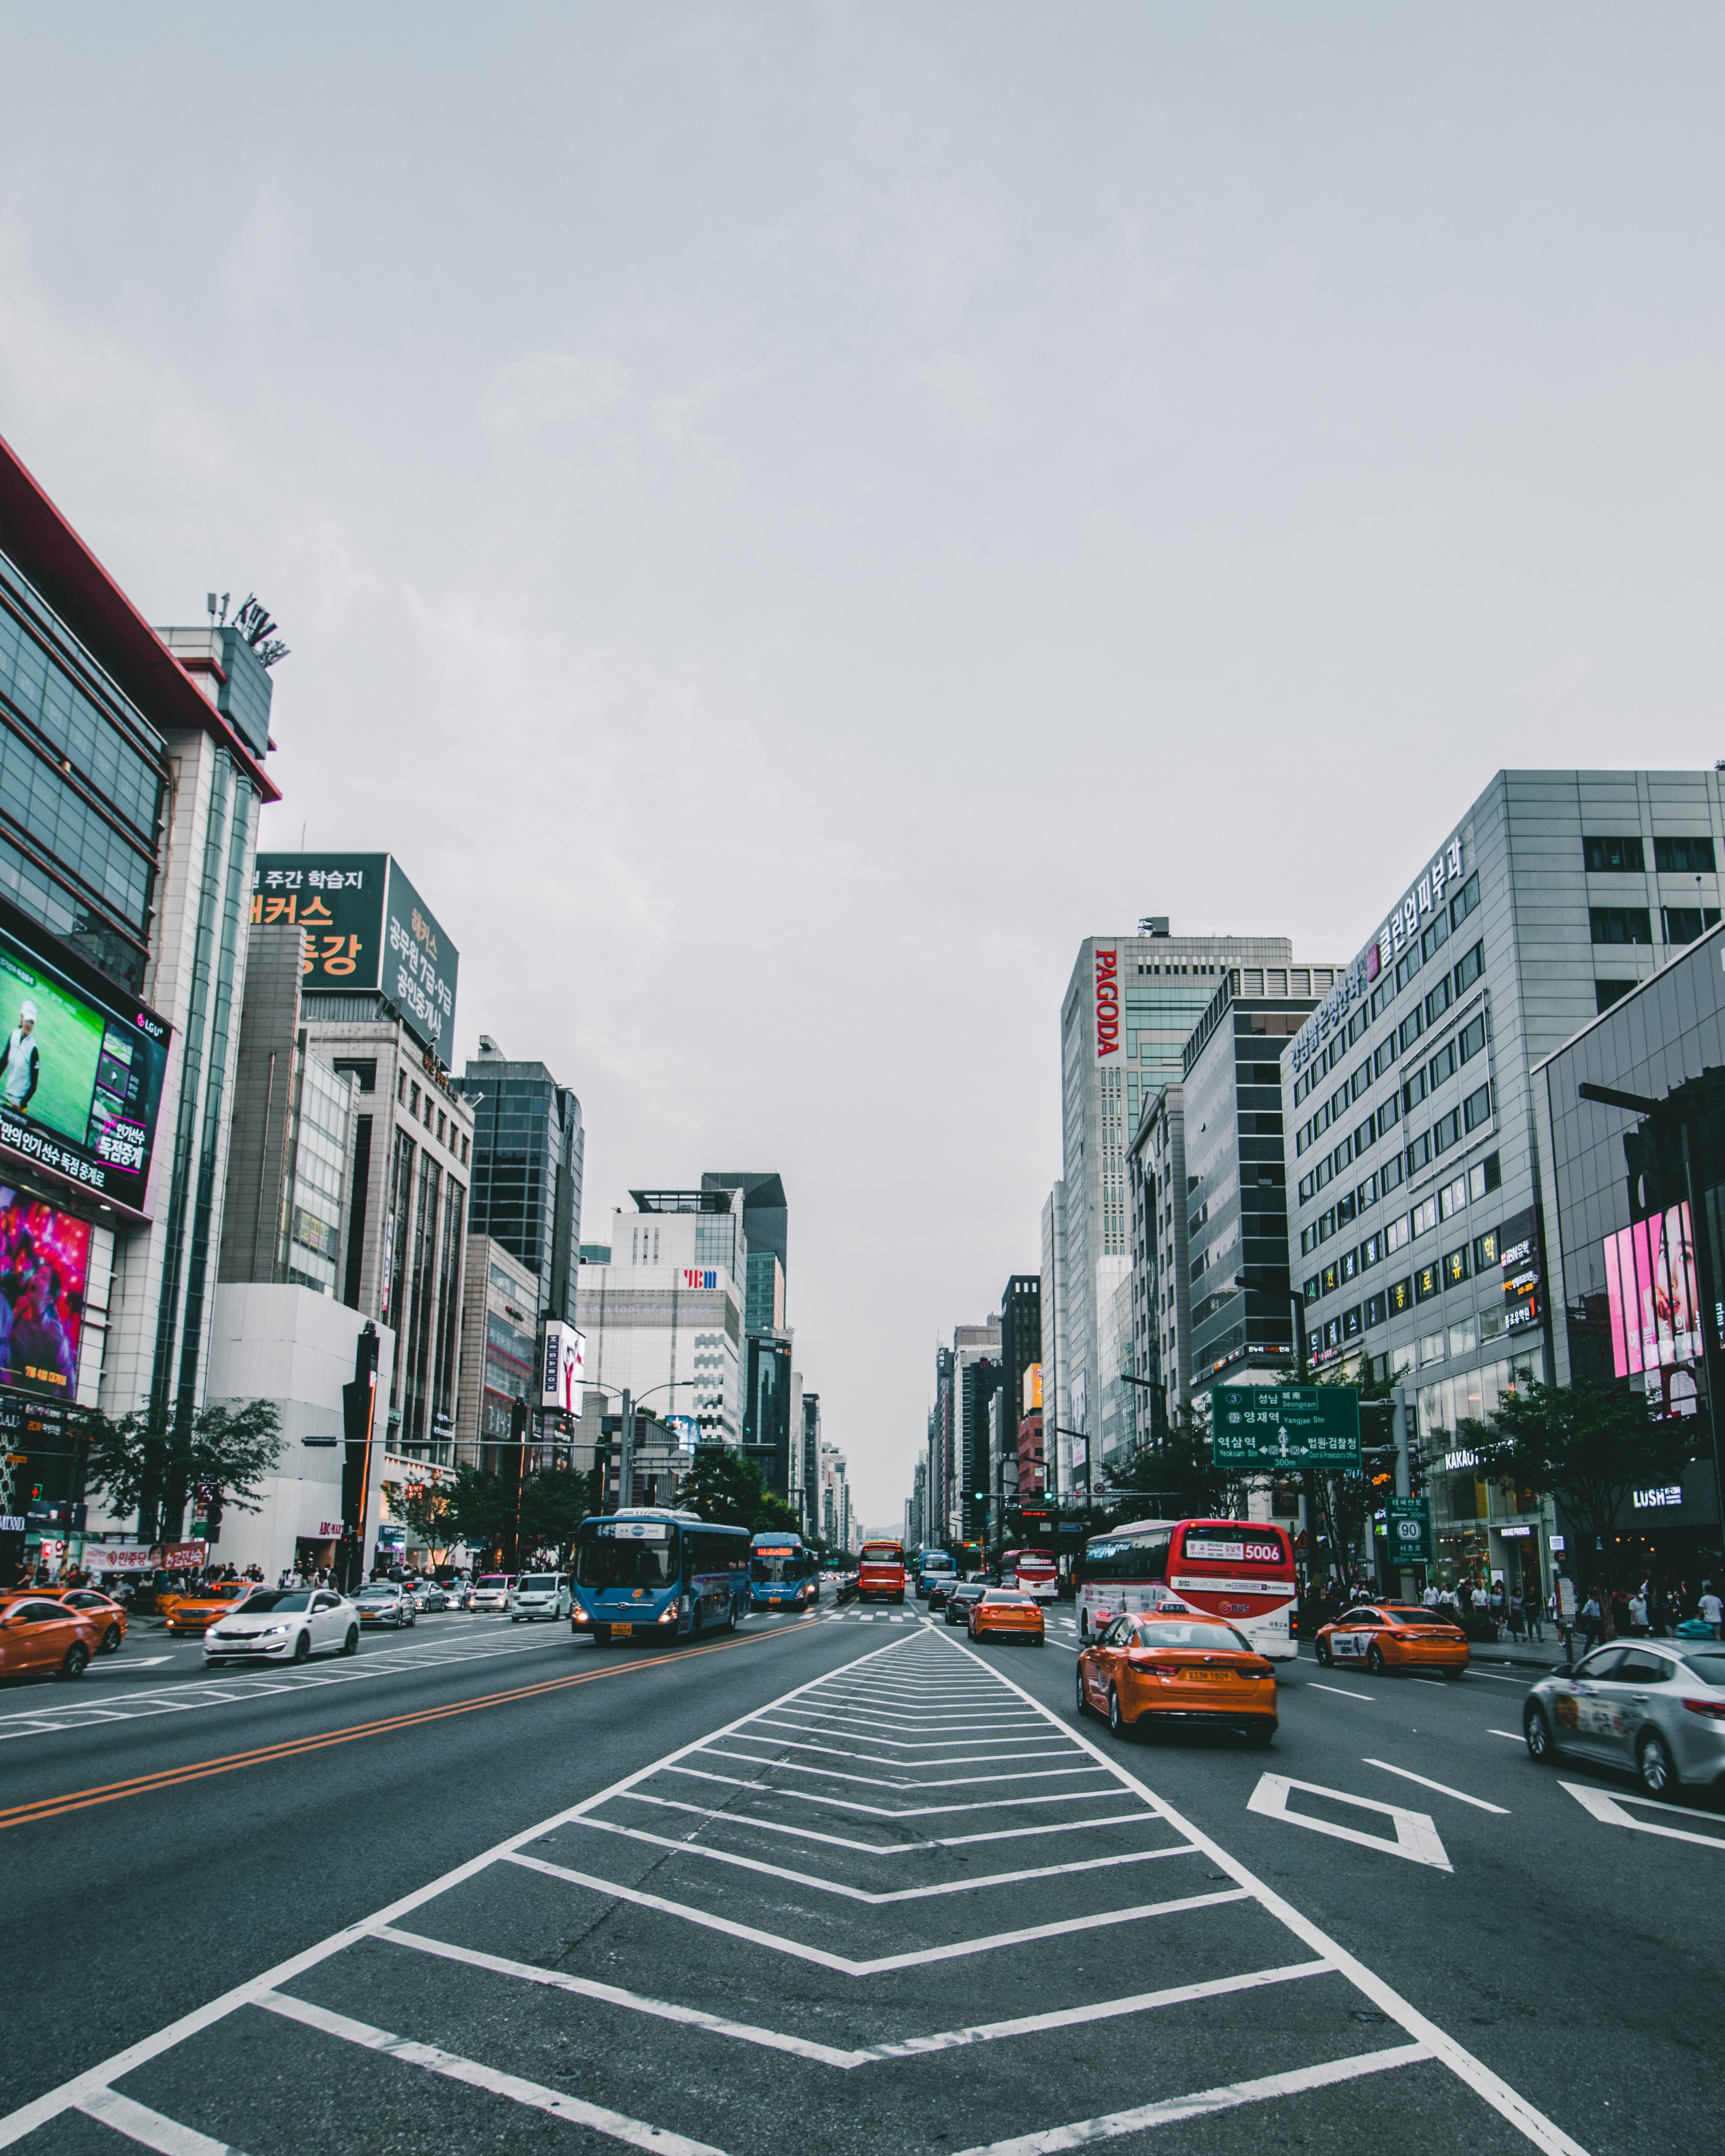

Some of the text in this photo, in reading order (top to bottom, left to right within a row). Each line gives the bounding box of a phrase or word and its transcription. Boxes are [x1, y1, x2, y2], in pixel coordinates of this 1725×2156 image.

[265, 870, 303, 889] 주간
[308, 870, 363, 889] 학습지
[1380, 835, 1464, 968] 클린업피부과
[389, 915, 419, 975] 공무원
[411, 907, 438, 962] 해커스
[397, 965, 442, 1040] 공인중개사
[1096, 949, 1119, 1058] PAGODA
[116, 1122, 146, 1146] 인기선수
[0, 1115, 21, 1147] 만의
[22, 1134, 43, 1157] 인기
[42, 1144, 60, 1166] 선수
[61, 1152, 79, 1177] 독점
[79, 1163, 105, 1188] 중계로
[99, 1136, 144, 1170] 독점중계
[684, 1269, 717, 1289] YBM
[1505, 1307, 1530, 1329] 종로유학원
[547, 1335, 557, 1391] MEGABOX
[1258, 1394, 1278, 1404] 성남
[1244, 1411, 1280, 1423] 양재역
[1217, 1436, 1255, 1448] 역삼역
[1445, 1449, 1474, 1470] KAKAO
[1633, 1489, 1665, 1508] LUSH
[1401, 1524, 1417, 1536] 90
[118, 1551, 147, 1567] 민중당
[1245, 1545, 1280, 1560] 5006
